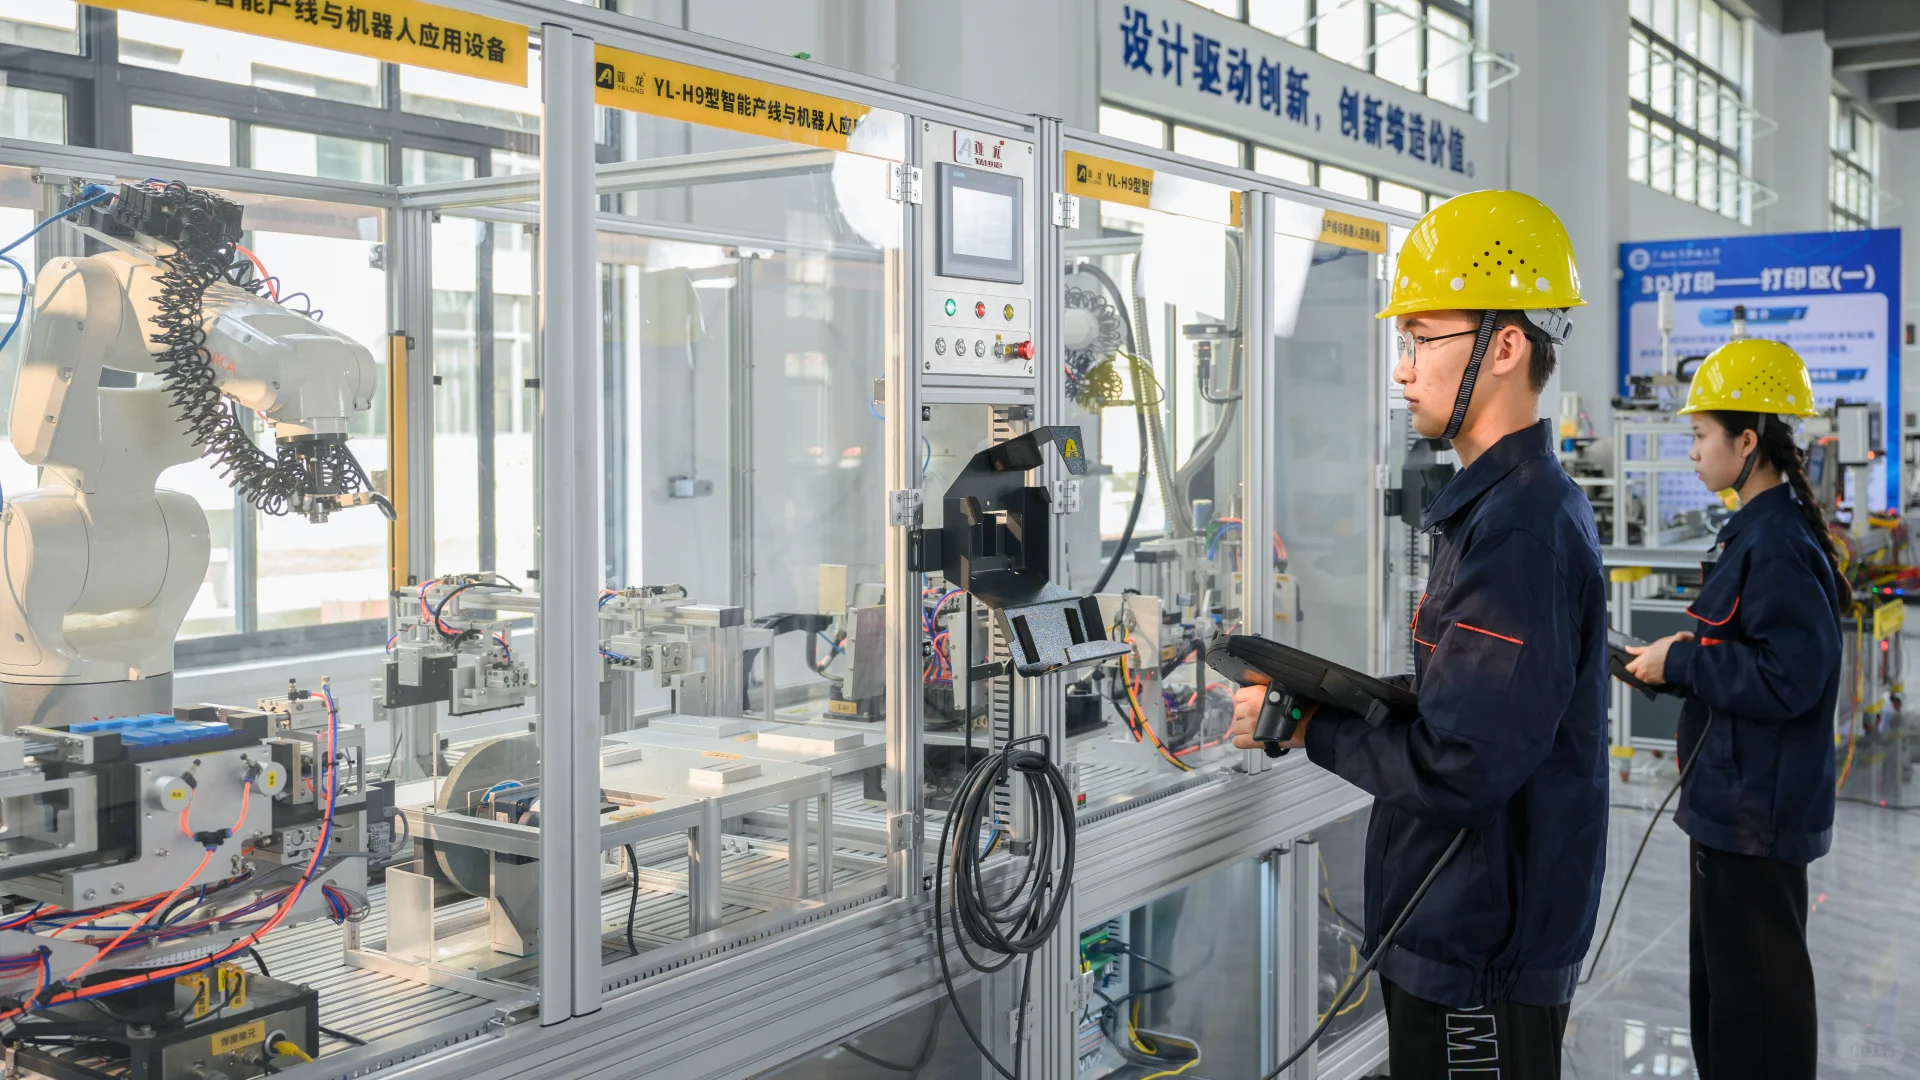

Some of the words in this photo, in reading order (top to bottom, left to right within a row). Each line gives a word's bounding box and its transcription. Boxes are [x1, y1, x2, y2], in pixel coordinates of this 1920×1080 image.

[195, 0, 507, 64] 能产线与机器人应用设备
[616, 84, 645, 95] YALONG
[1107, 172, 1151, 196] YL-H9型智
